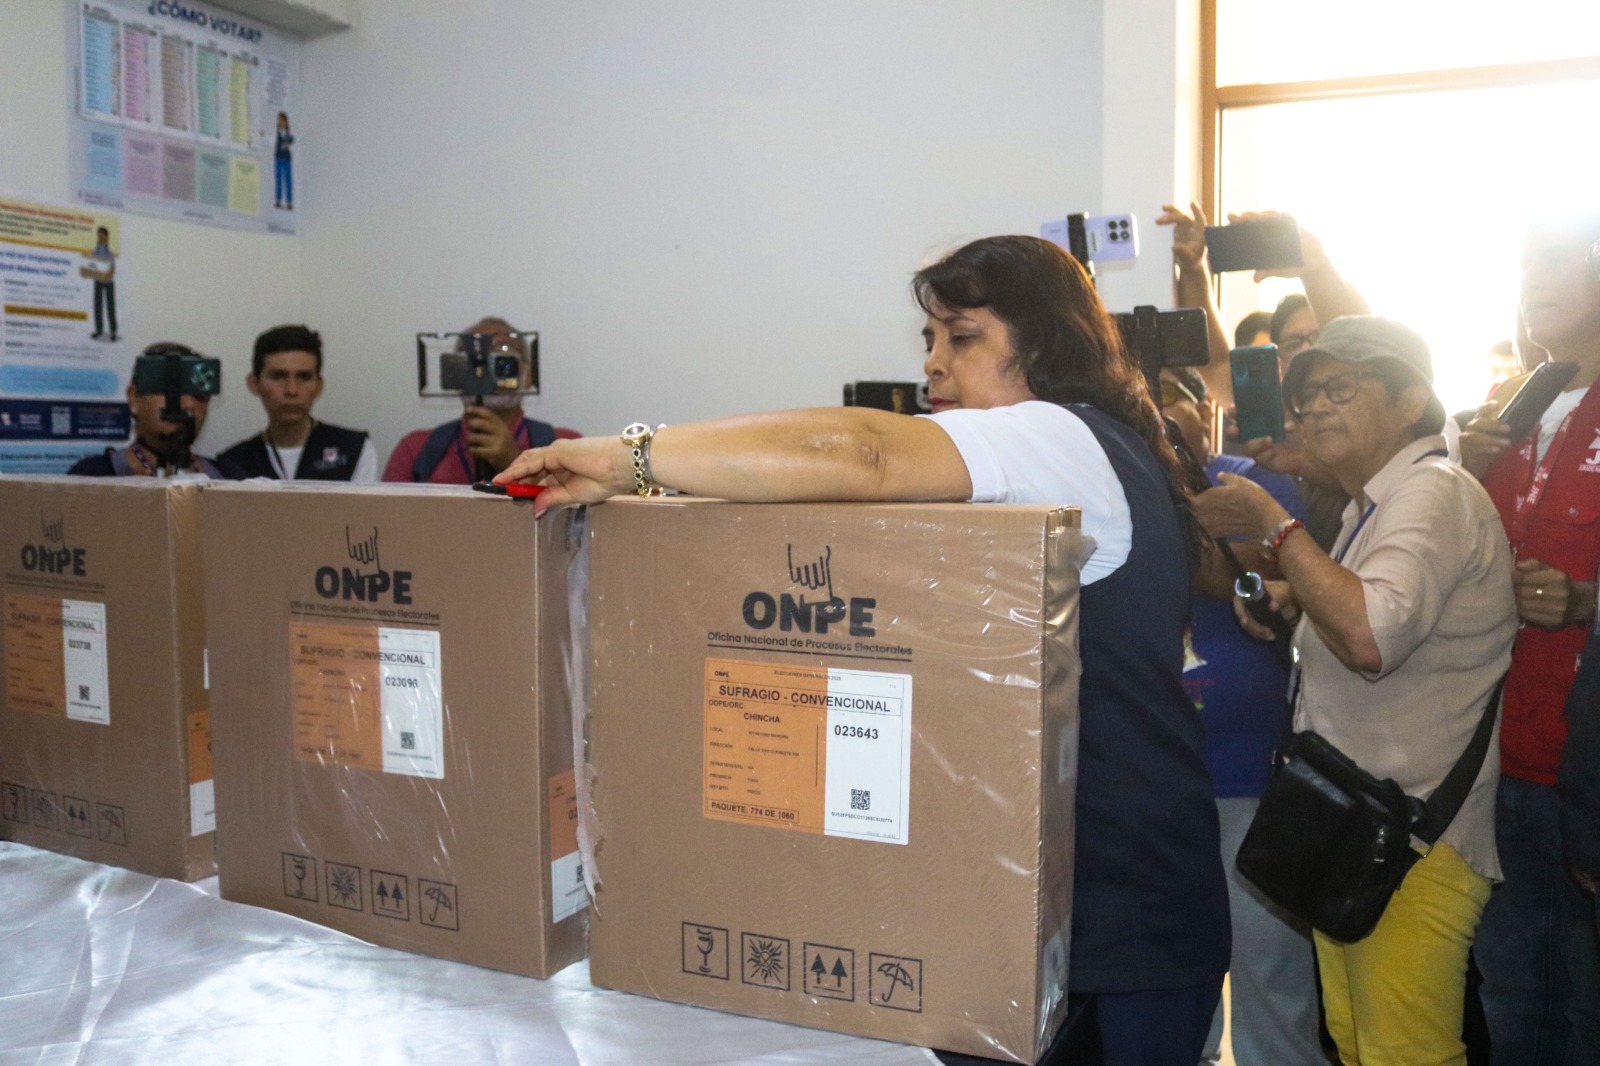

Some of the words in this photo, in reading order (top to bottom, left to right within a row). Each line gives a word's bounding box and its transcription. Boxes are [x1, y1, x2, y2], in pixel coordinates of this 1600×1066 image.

[148, 0, 207, 27] ¿CÓMO
[210, 16, 263, 42] VOTAR?
[1527, 485, 1539, 504] JNE
[21, 543, 86, 576] ONPE
[315, 565, 413, 604] ONPE
[397, 610, 440, 620] Electorales
[743, 591, 876, 637] ONPE
[708, 631, 742, 643] Oficina
[744, 635, 788, 647] Nacional
[790, 638, 803, 647] de
[806, 639, 852, 651] Procesos
[854, 643, 913, 656] Electorales
[355, 650, 425, 665] CONVENCIONAL
[719, 684, 781, 702] SUFRAGIO
[791, 691, 891, 713] CONVENCIONAL
[743, 712, 781, 724] CHINCHA
[834, 724, 879, 740] 023643
[711, 801, 748, 814] PAQUETE:
[750, 806, 763, 816] 774
[765, 809, 776, 818] DE
[778, 811, 795, 820] 1060
